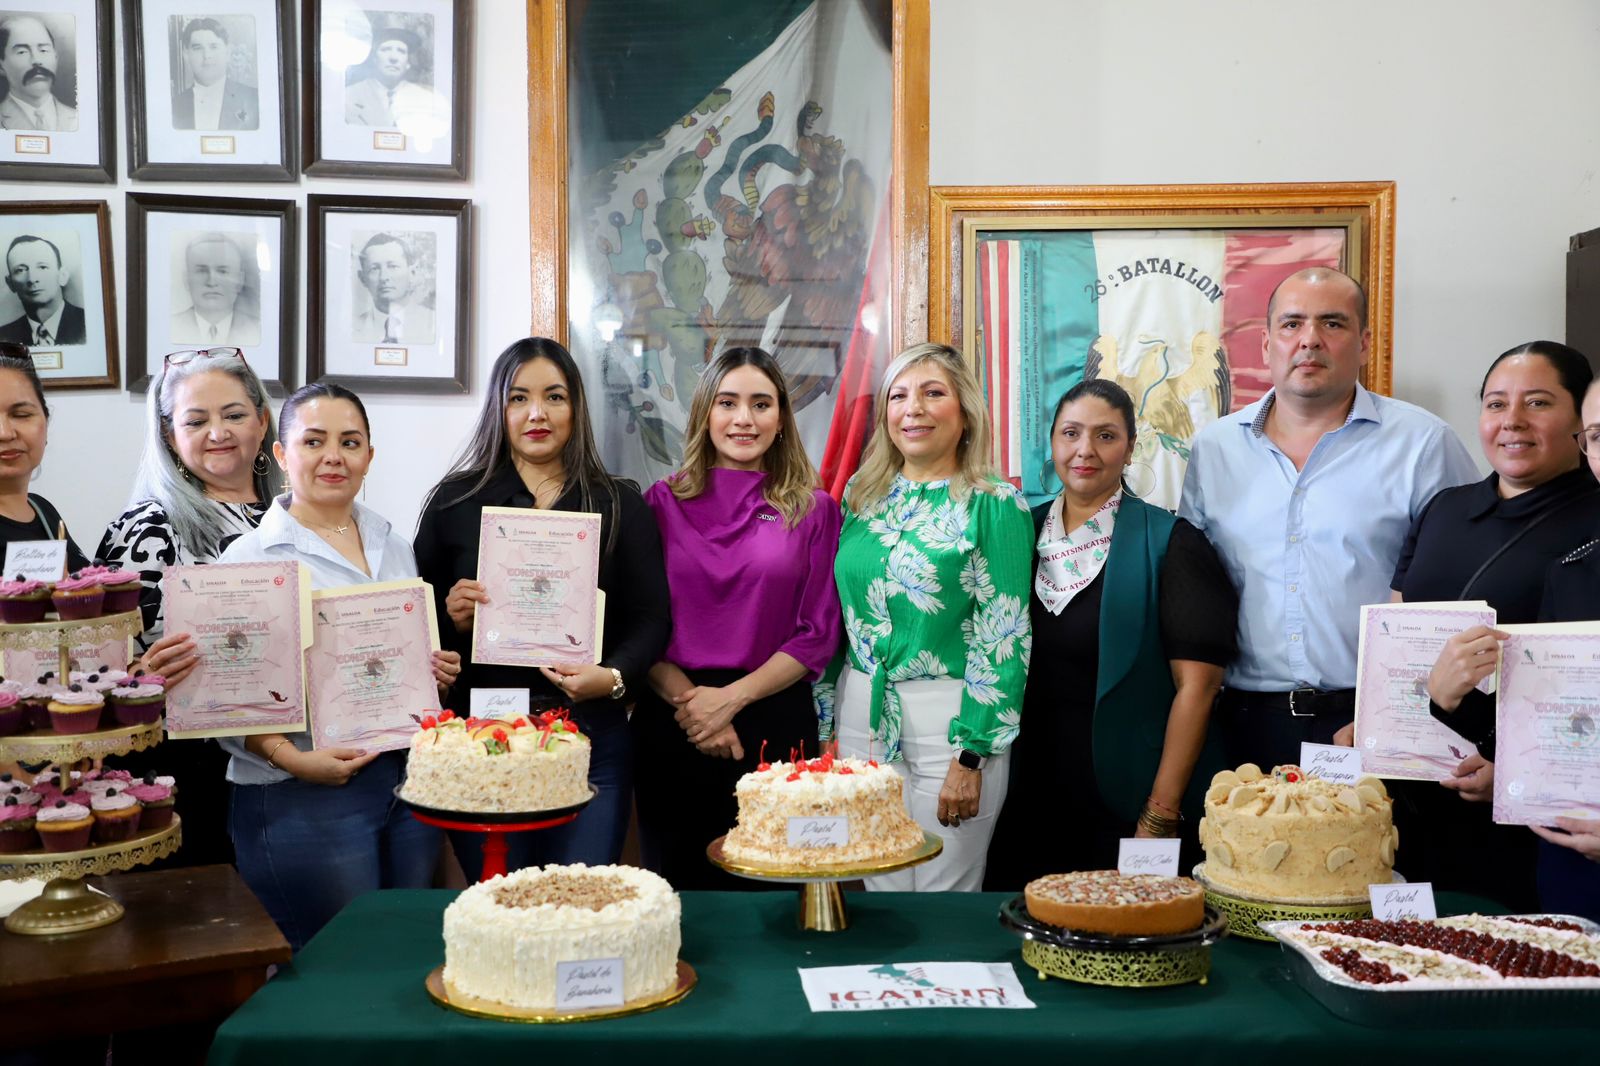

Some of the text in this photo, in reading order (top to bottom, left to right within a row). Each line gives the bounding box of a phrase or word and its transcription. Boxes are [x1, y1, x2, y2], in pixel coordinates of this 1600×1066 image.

[1117, 257, 1224, 304] BATALLON
[1084, 535, 1113, 551] ICATSIN
[1051, 545, 1084, 562] ICATSIN
[507, 568, 571, 579] CONSTANCIA
[195, 620, 270, 635] CONSTANCIA
[336, 647, 405, 665] CONSTANCIA
[1311, 751, 1349, 764] Pastel
[800, 821, 837, 836] Pastel
[1384, 889, 1419, 906] Pastel
[829, 987, 1006, 1003] ICATSIN
